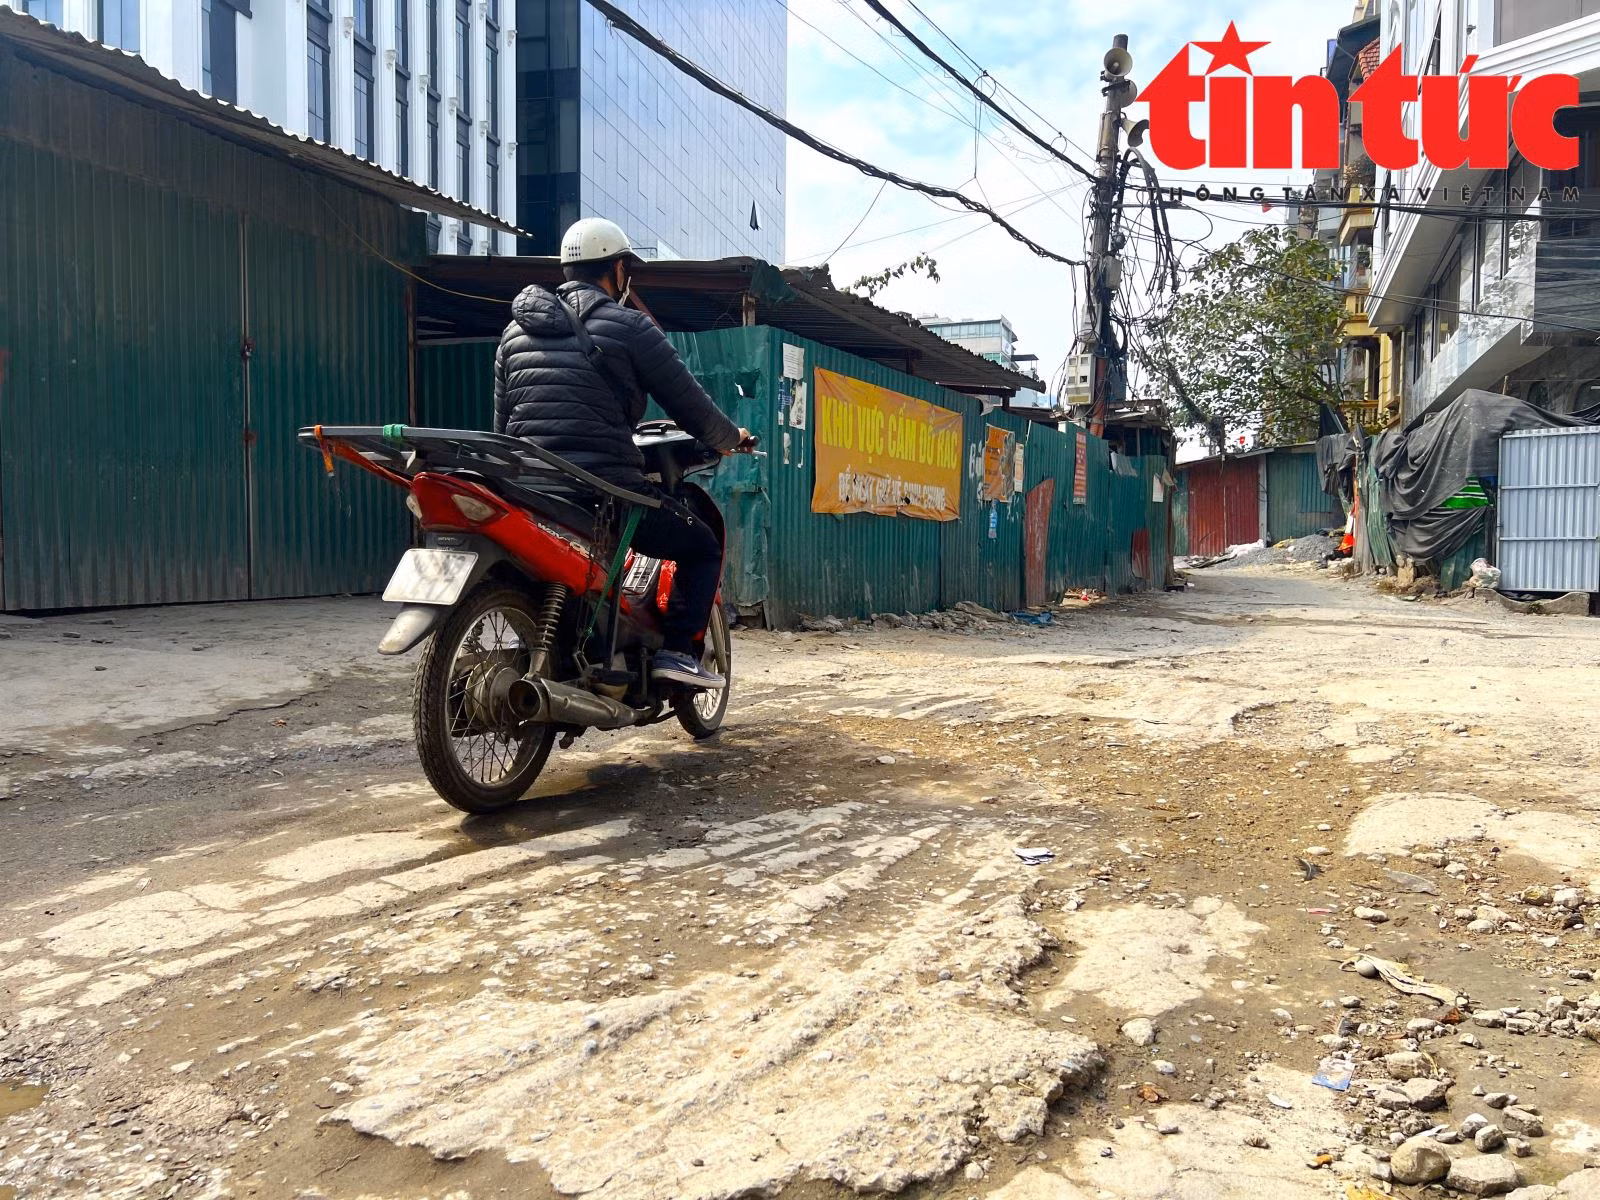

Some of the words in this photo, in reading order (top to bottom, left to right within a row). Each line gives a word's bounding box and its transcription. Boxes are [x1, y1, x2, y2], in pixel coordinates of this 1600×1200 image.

[822, 395, 854, 449] KHU
[857, 405, 885, 464] VỰC
[888, 402, 917, 461] CẤM
